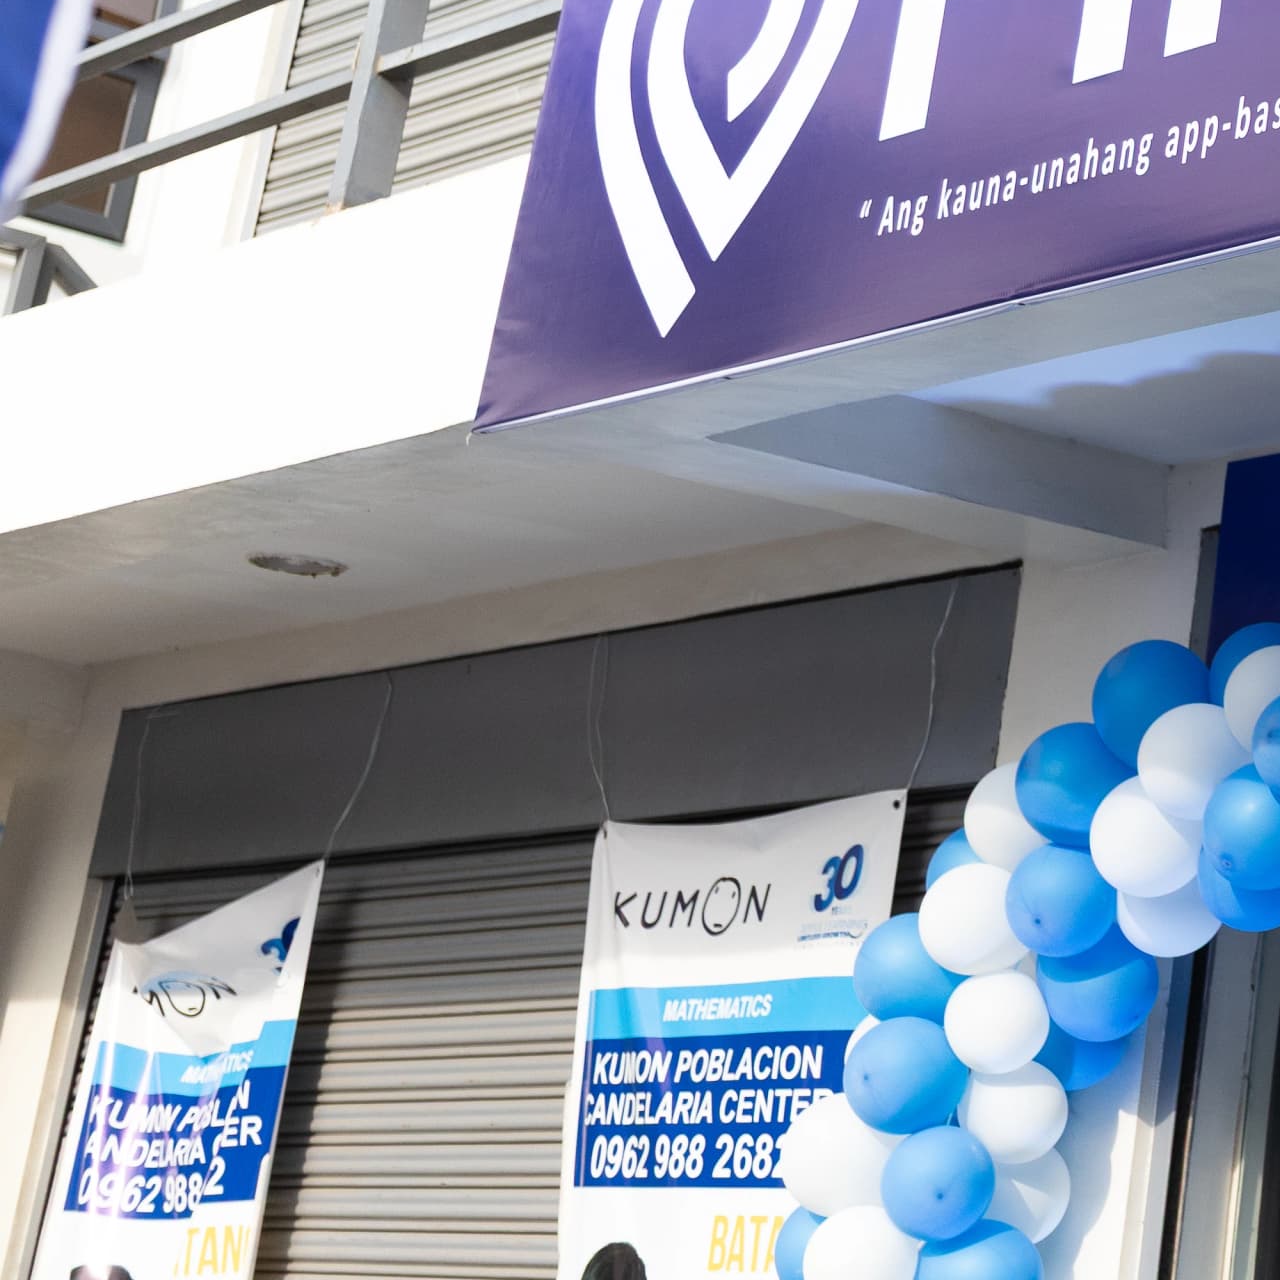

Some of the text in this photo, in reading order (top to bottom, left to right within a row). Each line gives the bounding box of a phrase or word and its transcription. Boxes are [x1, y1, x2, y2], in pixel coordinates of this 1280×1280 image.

[877, 195, 928, 236] Ang
[937, 131, 1154, 221] kauna-unahang
[814, 843, 864, 912] 30
[614, 876, 771, 936] KUMON
[663, 994, 773, 1021] MATHEMATICS
[593, 1044, 823, 1085] KUMON POBLACION
[584, 1090, 713, 1126] CANDELARIA
[590, 1134, 649, 1179] 0962
[654, 1133, 706, 1179] 988
